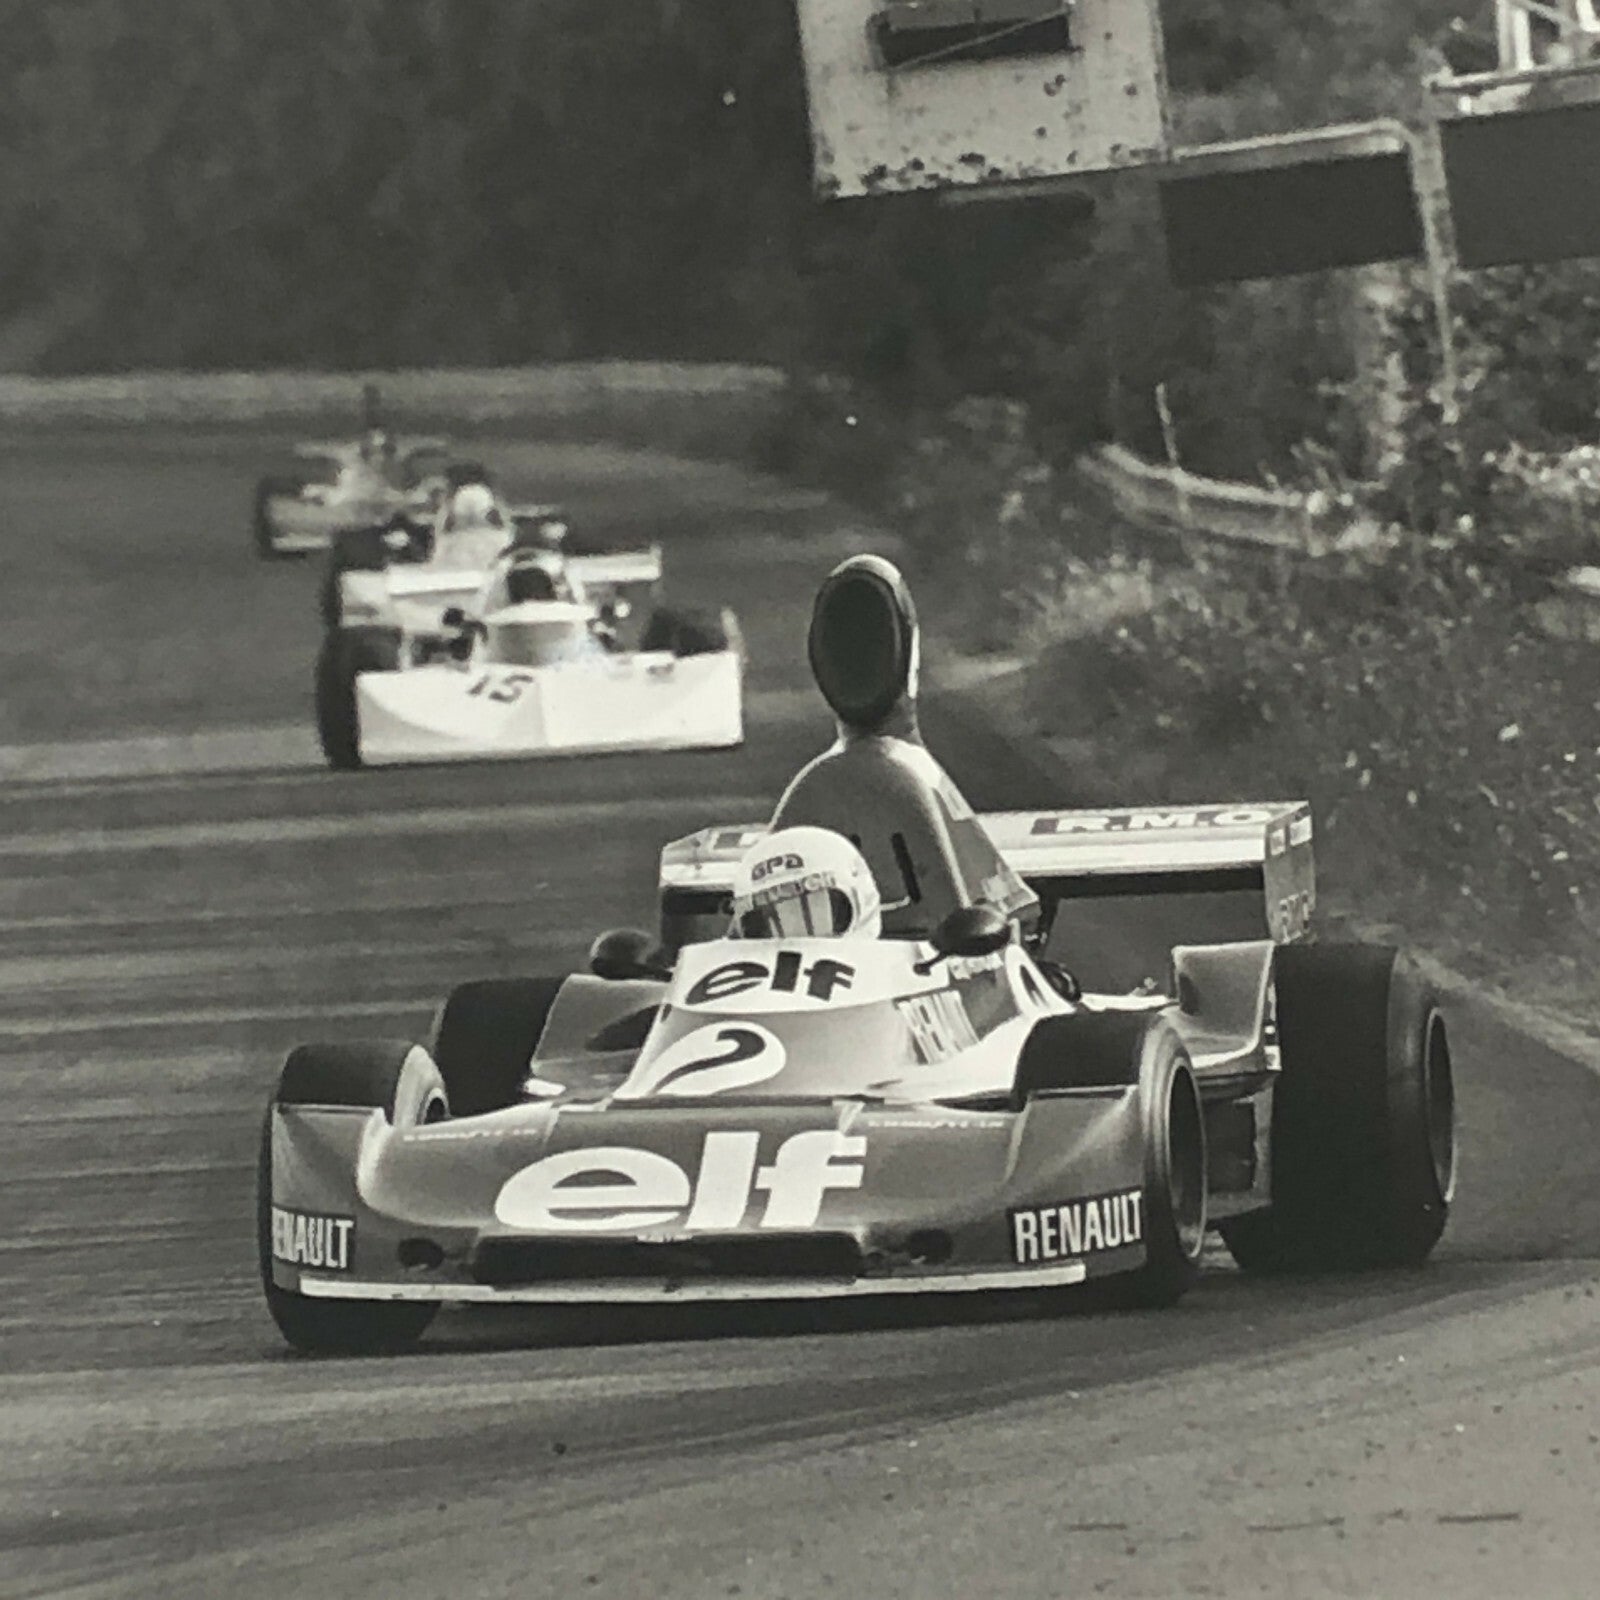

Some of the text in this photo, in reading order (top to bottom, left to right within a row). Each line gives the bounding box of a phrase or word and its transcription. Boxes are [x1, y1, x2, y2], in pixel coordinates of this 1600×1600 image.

[685, 951, 855, 1005] elf
[653, 1029, 766, 1096] 2
[495, 1130, 867, 1231] elf
[272, 1206, 354, 1269] ENAULT
[1013, 1190, 1143, 1263] RENAULT
